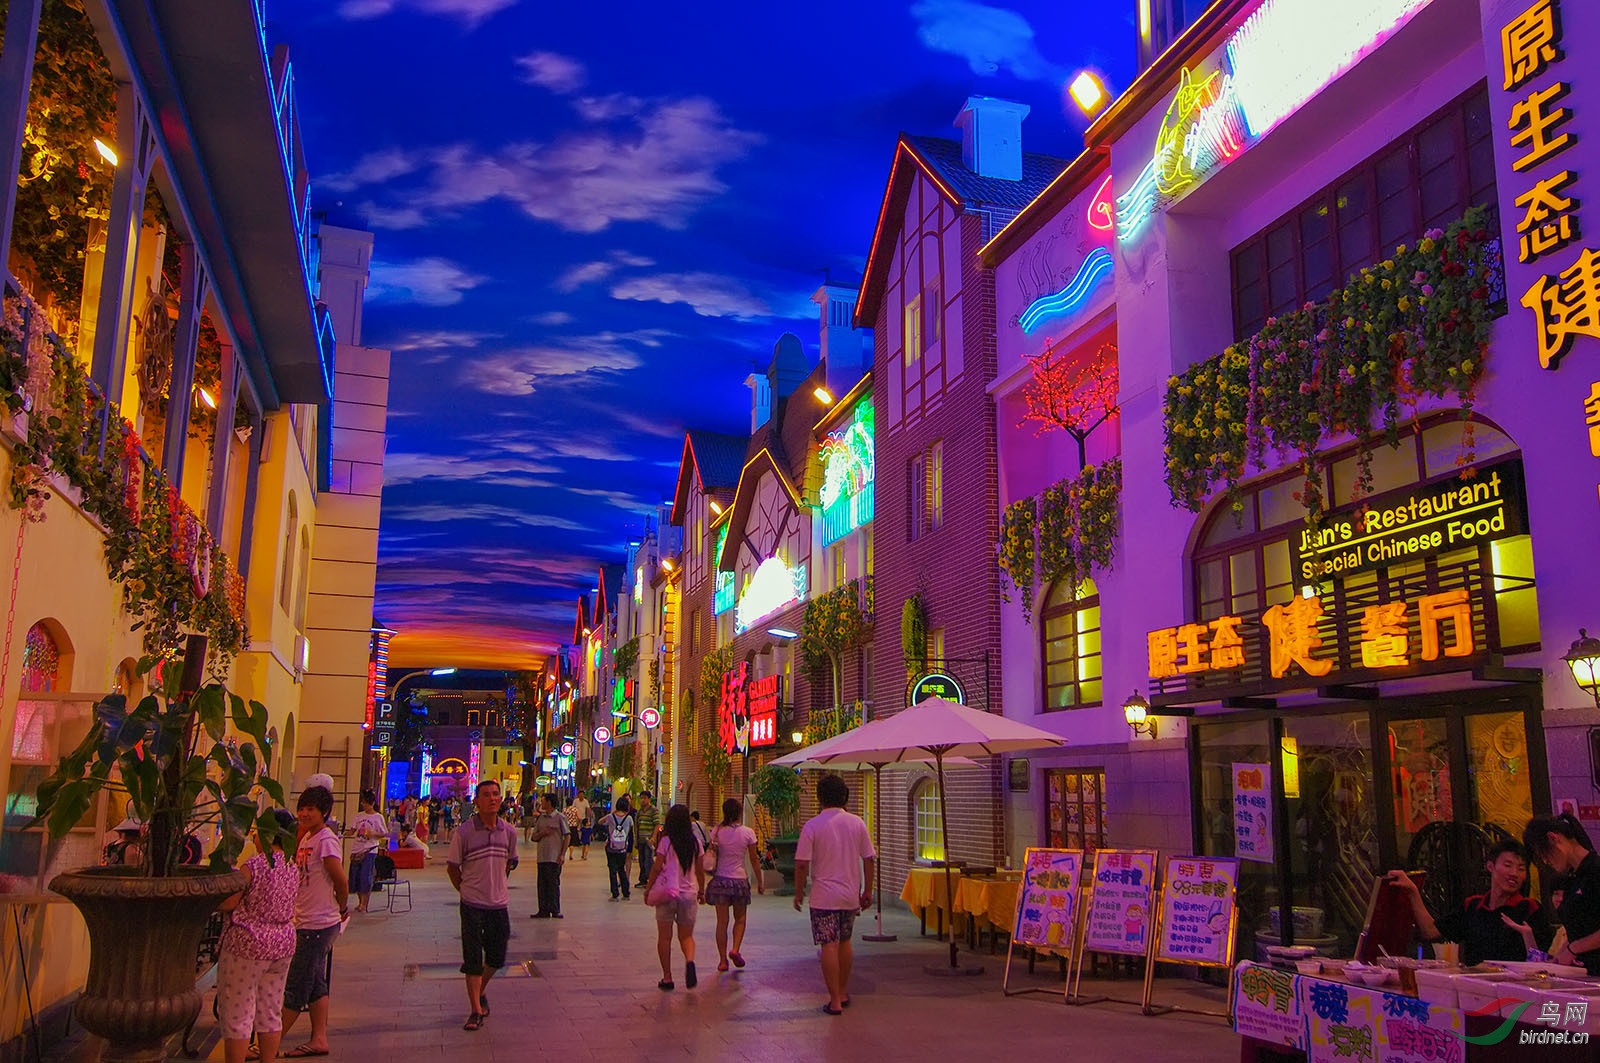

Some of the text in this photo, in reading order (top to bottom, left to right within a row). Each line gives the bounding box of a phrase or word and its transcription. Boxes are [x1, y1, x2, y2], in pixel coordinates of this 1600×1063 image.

[1364, 471, 1501, 533] Restaurant
[1302, 507, 1504, 579] Secial Chinese Food
[380, 703, 393, 718] P
